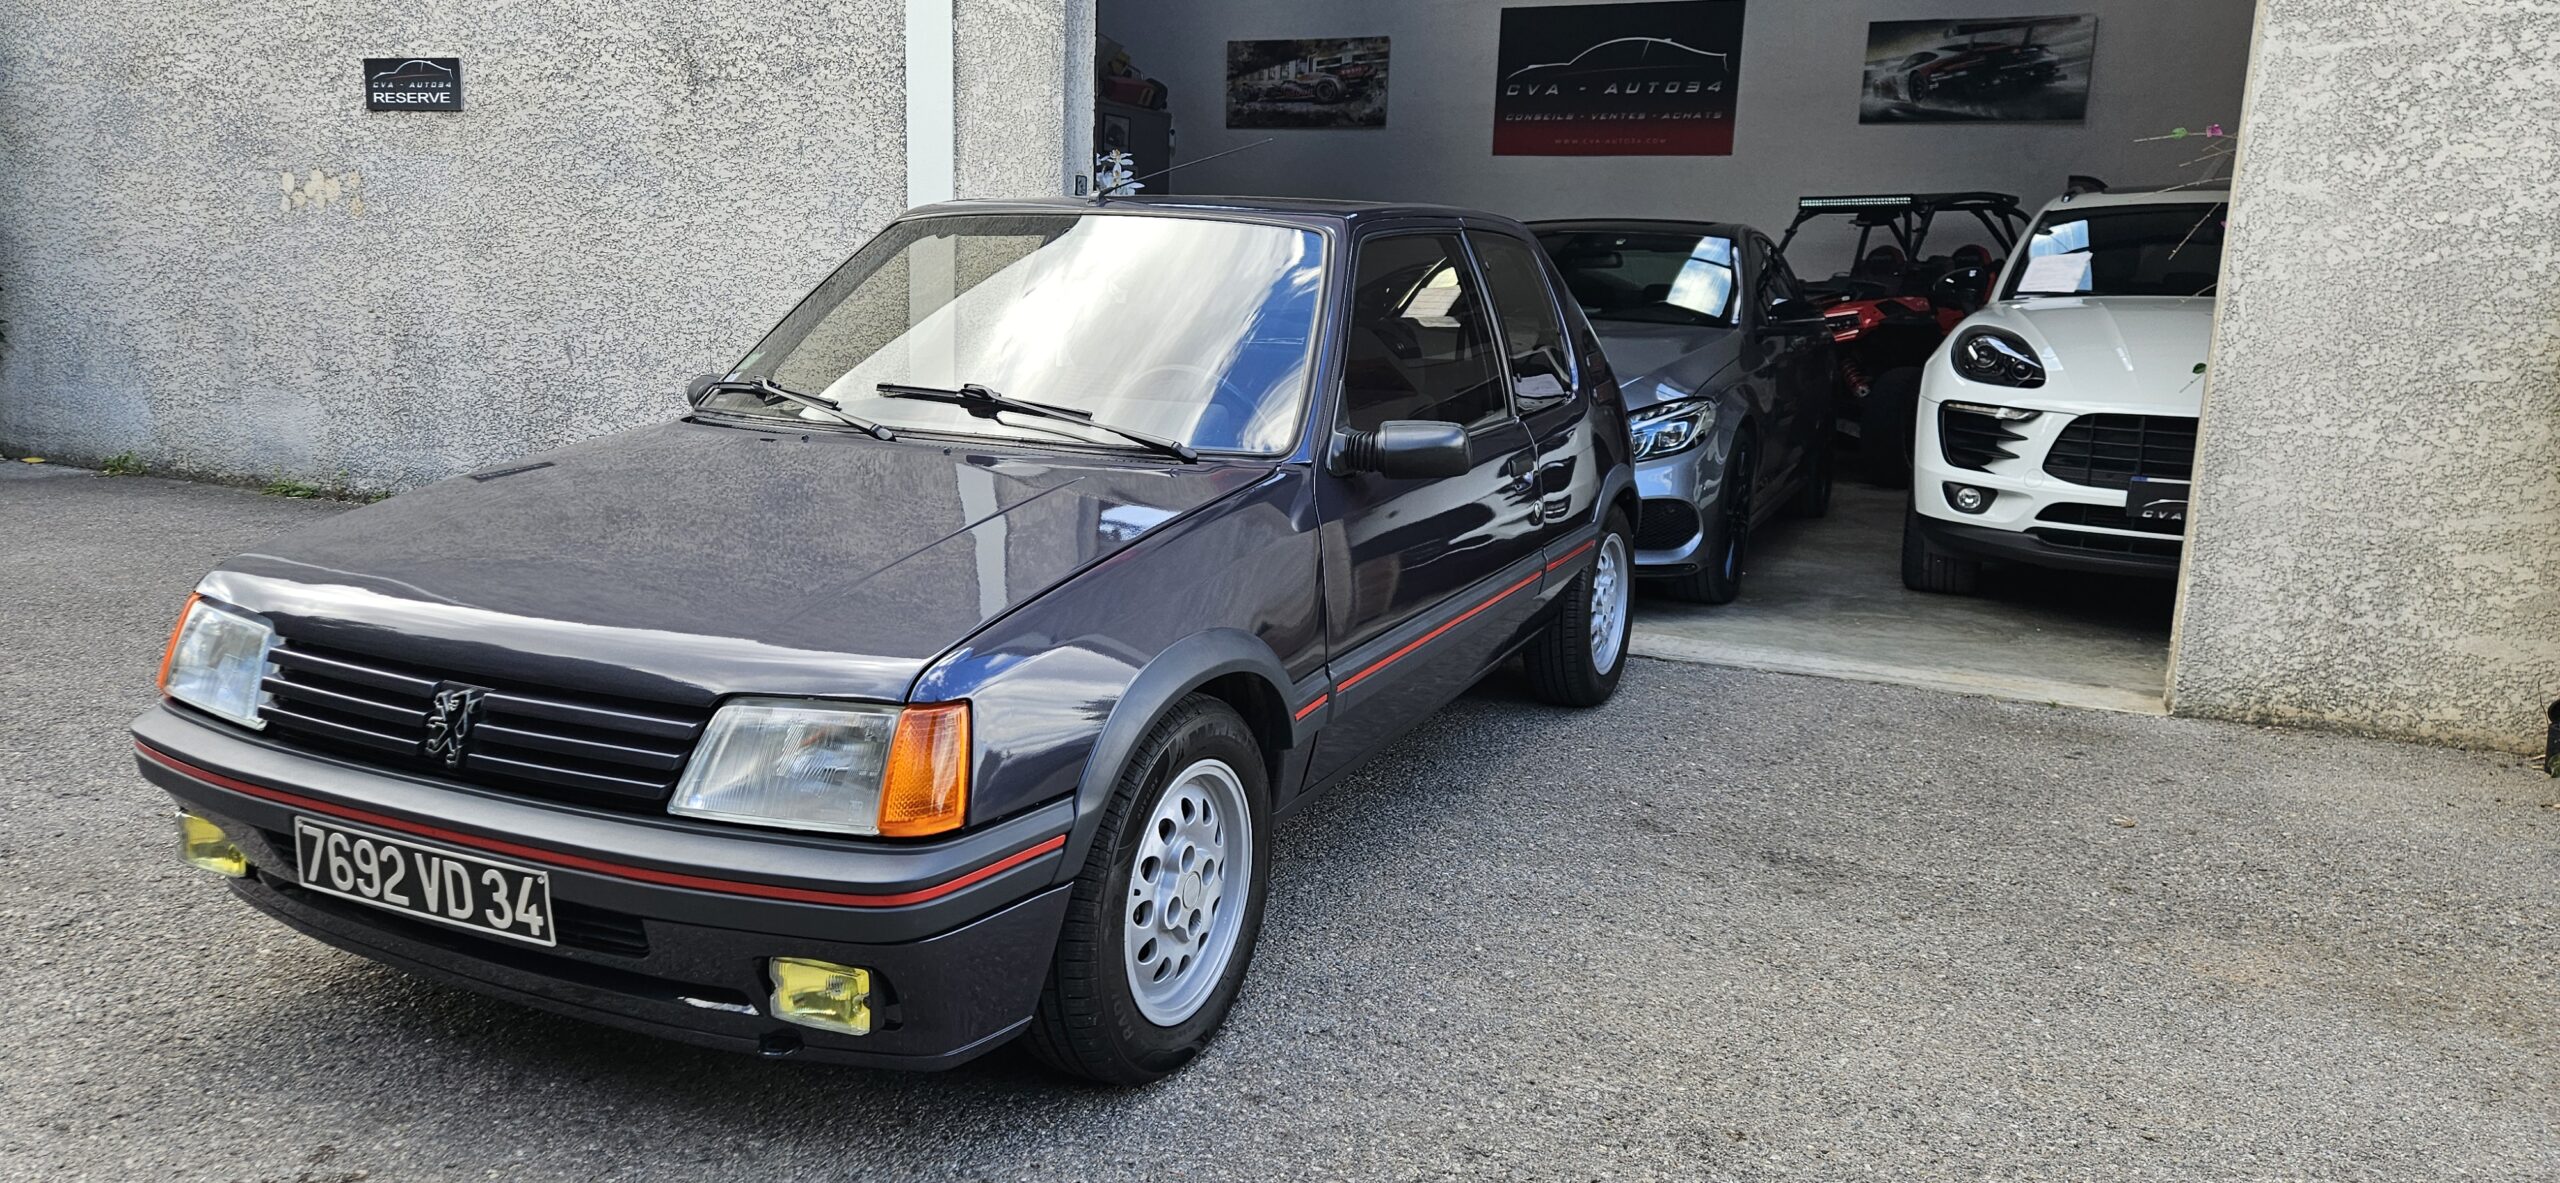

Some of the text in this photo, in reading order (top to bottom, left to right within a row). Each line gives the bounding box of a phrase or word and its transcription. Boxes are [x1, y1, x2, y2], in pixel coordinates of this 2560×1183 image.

[1506, 83, 1559, 96] CVA
[1603, 81, 1723, 95] AUTO34
[373, 92, 451, 104] RESERVE
[1505, 112, 1575, 122] CONSEILS
[1590, 112, 1647, 121] VENTES
[1661, 111, 1723, 120] ACHATS
[2142, 510, 2182, 520] CVA
[302, 824, 545, 936] 7692 VD 34
